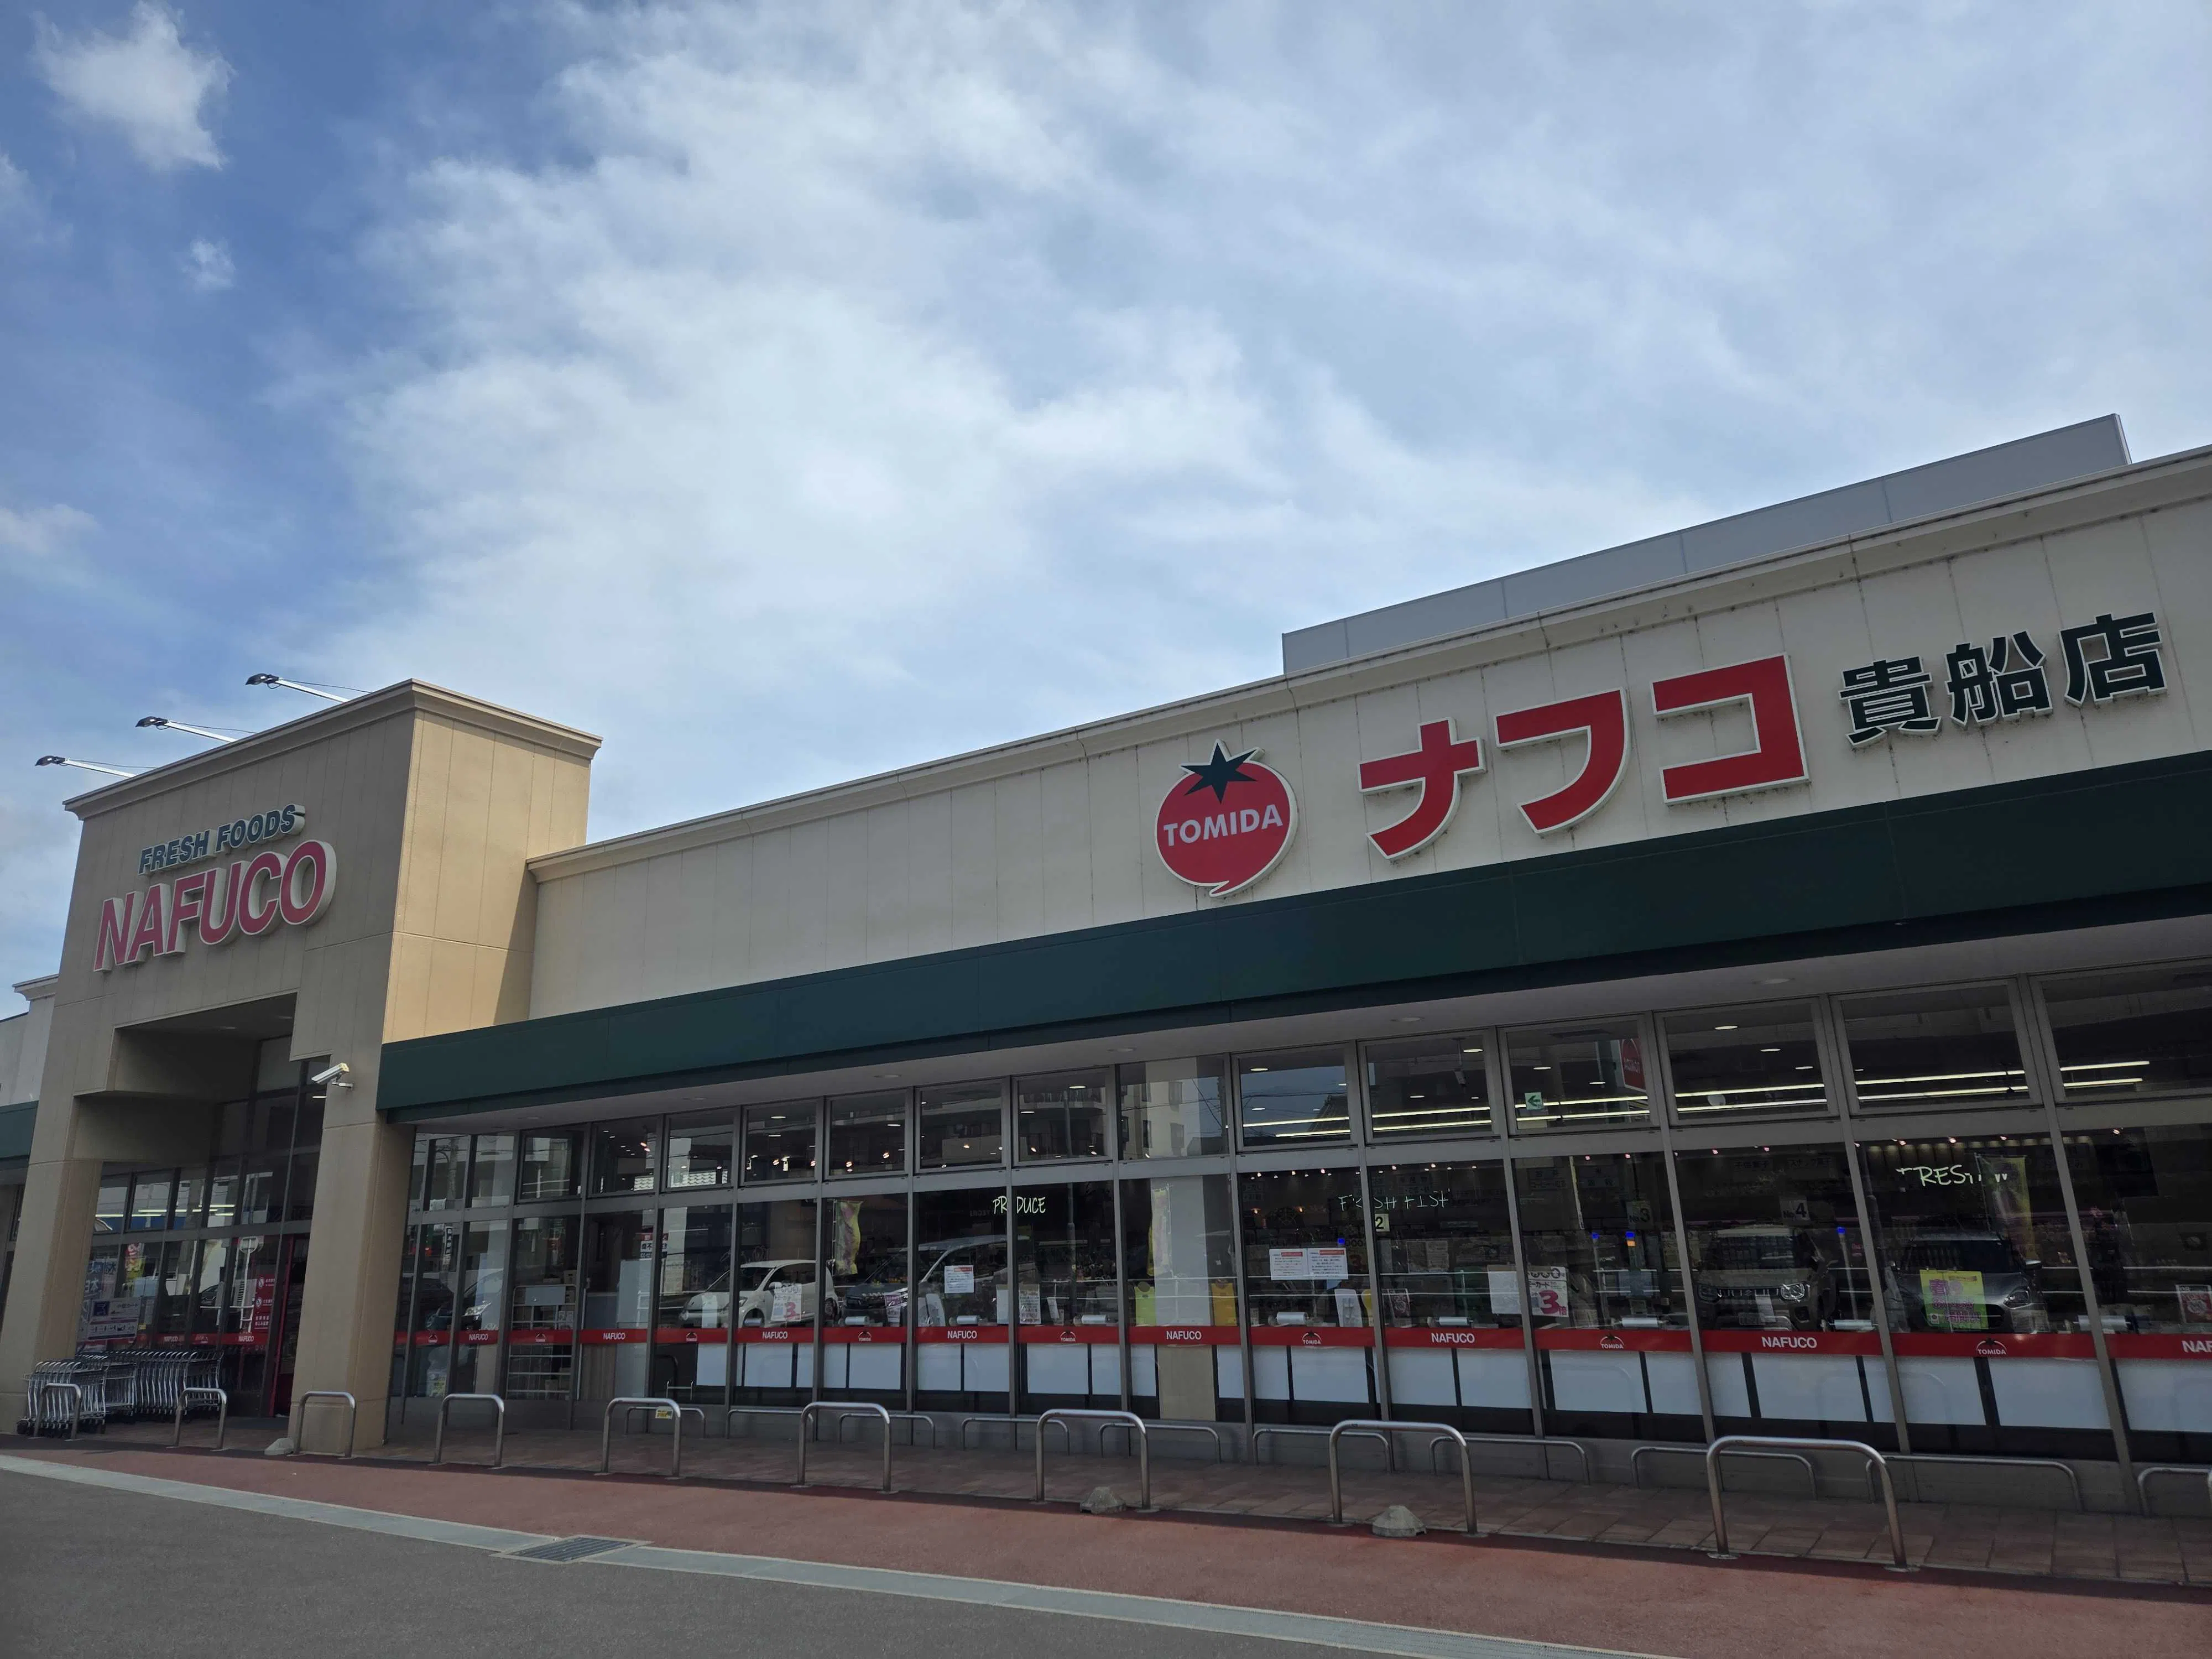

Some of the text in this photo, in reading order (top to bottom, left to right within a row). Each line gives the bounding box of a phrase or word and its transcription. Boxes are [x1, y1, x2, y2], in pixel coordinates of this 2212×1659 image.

[1359, 612, 2167, 860] ナフコ 貴船店
[1164, 804, 1283, 847] TOMIDA
[138, 804, 299, 875] FRESH FOODS
[94, 841, 330, 972] NAFUCO
[992, 1196, 1046, 1214] PRDUCE
[603, 1332, 625, 1340] NAFUCO
[762, 1331, 788, 1339] NAFUCO
[947, 1331, 977, 1339] NAFUCO
[1166, 1331, 1202, 1340] NAFUCO
[1431, 1333, 1475, 1344] NAFUCO
[1761, 1337, 1817, 1349] NAFUCO
